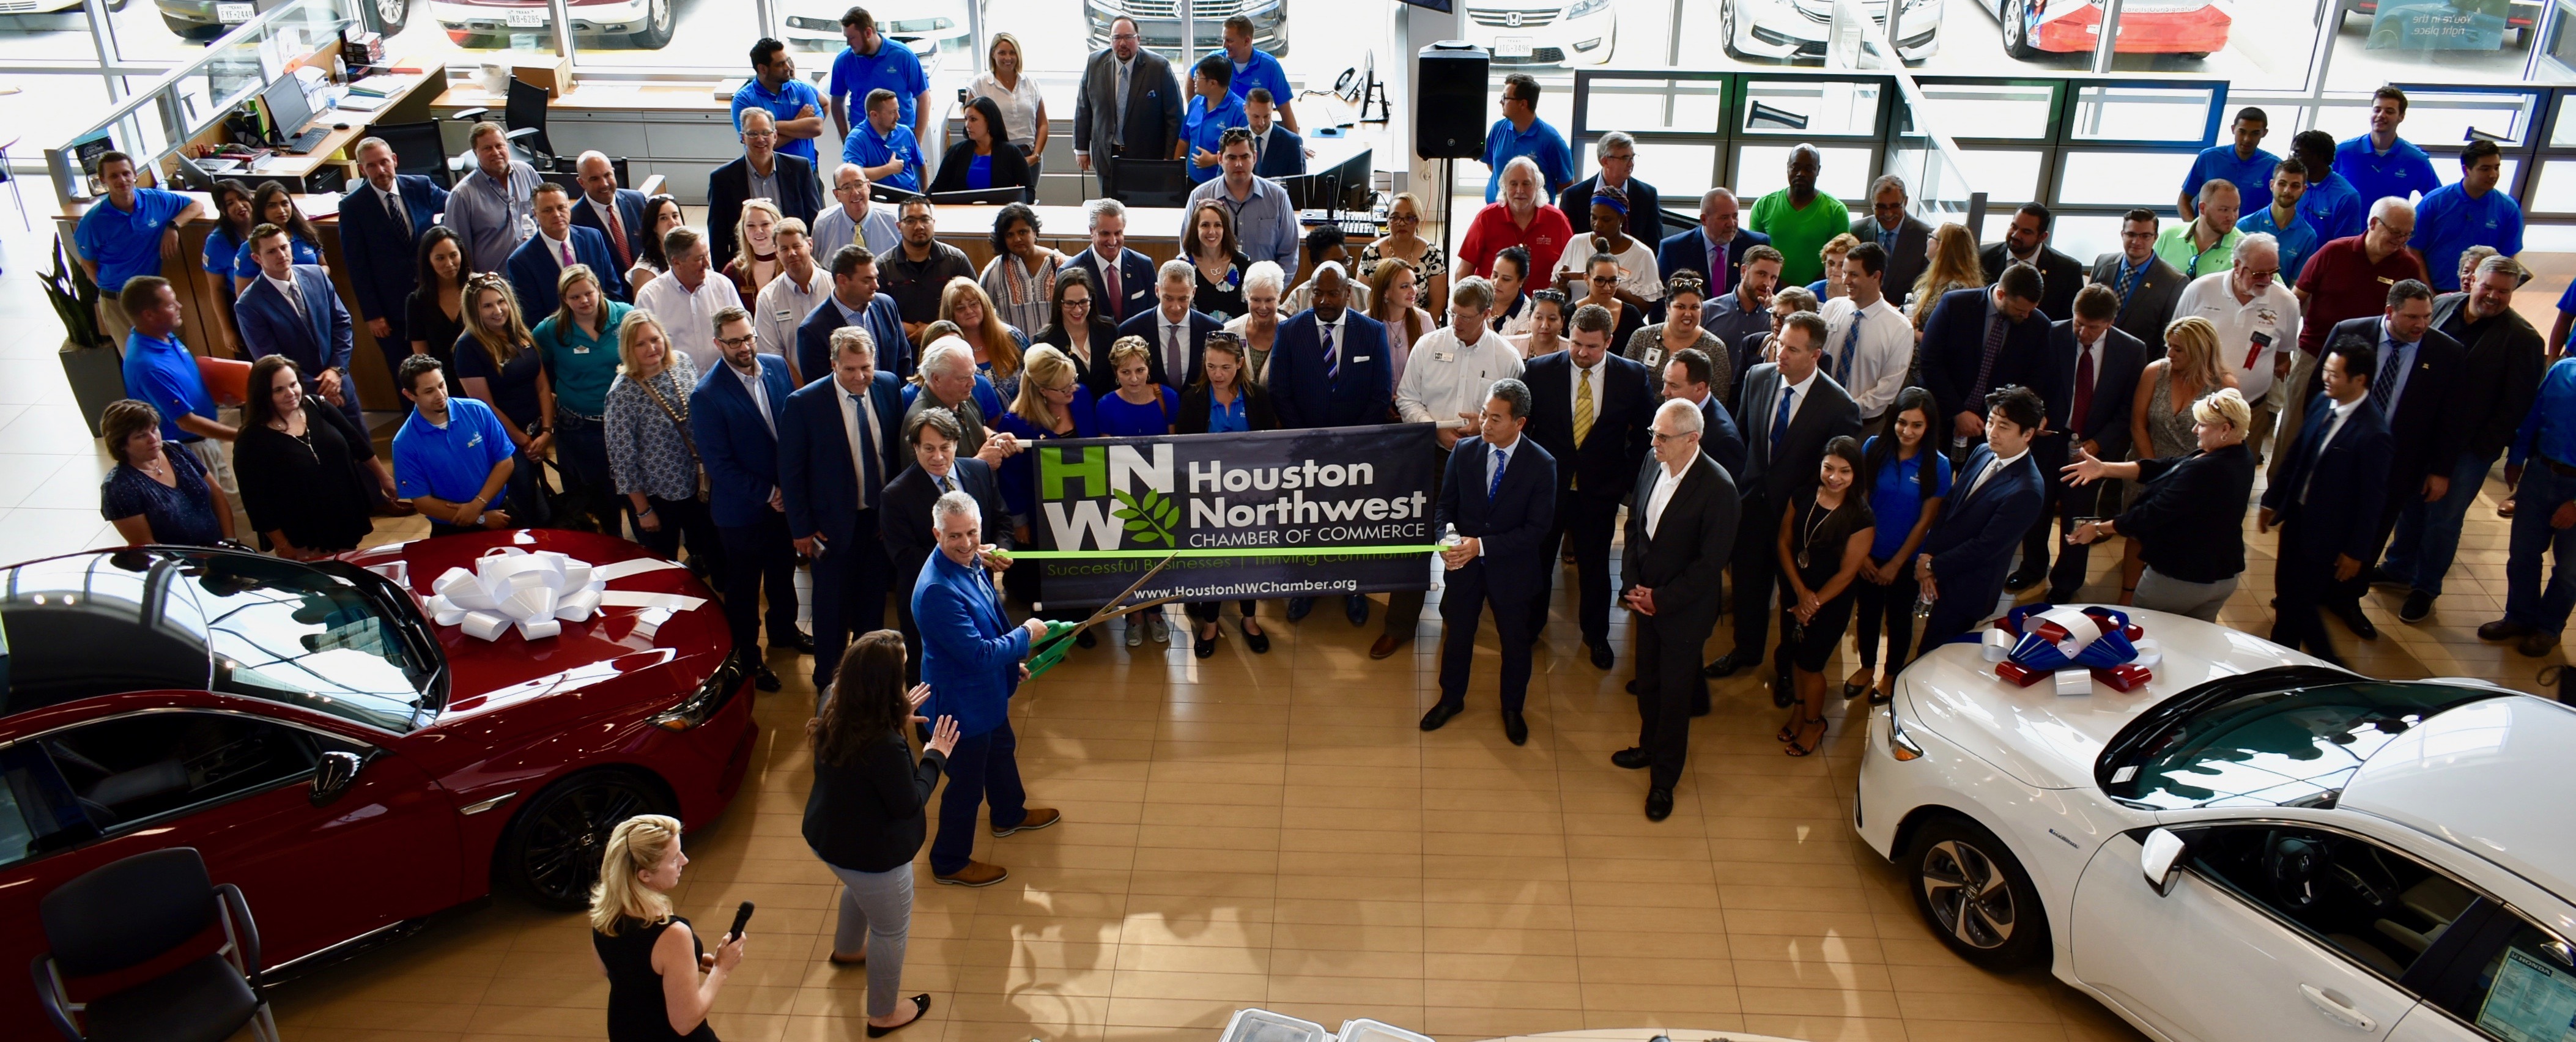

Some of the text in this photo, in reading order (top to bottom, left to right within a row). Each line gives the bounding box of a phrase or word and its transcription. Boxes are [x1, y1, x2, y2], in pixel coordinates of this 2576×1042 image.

[1189, 459, 1374, 493] Houston
[1190, 490, 1427, 529] Northwest
[1190, 523, 1426, 547] CHAMBER OF COMMERCE
[1047, 560, 1138, 576] Successful
[1144, 558, 1232, 572] Bsinesses
[1134, 579, 1357, 599] www.HoustonNWChamber.org
[2518, 956, 2551, 975] HONDA
